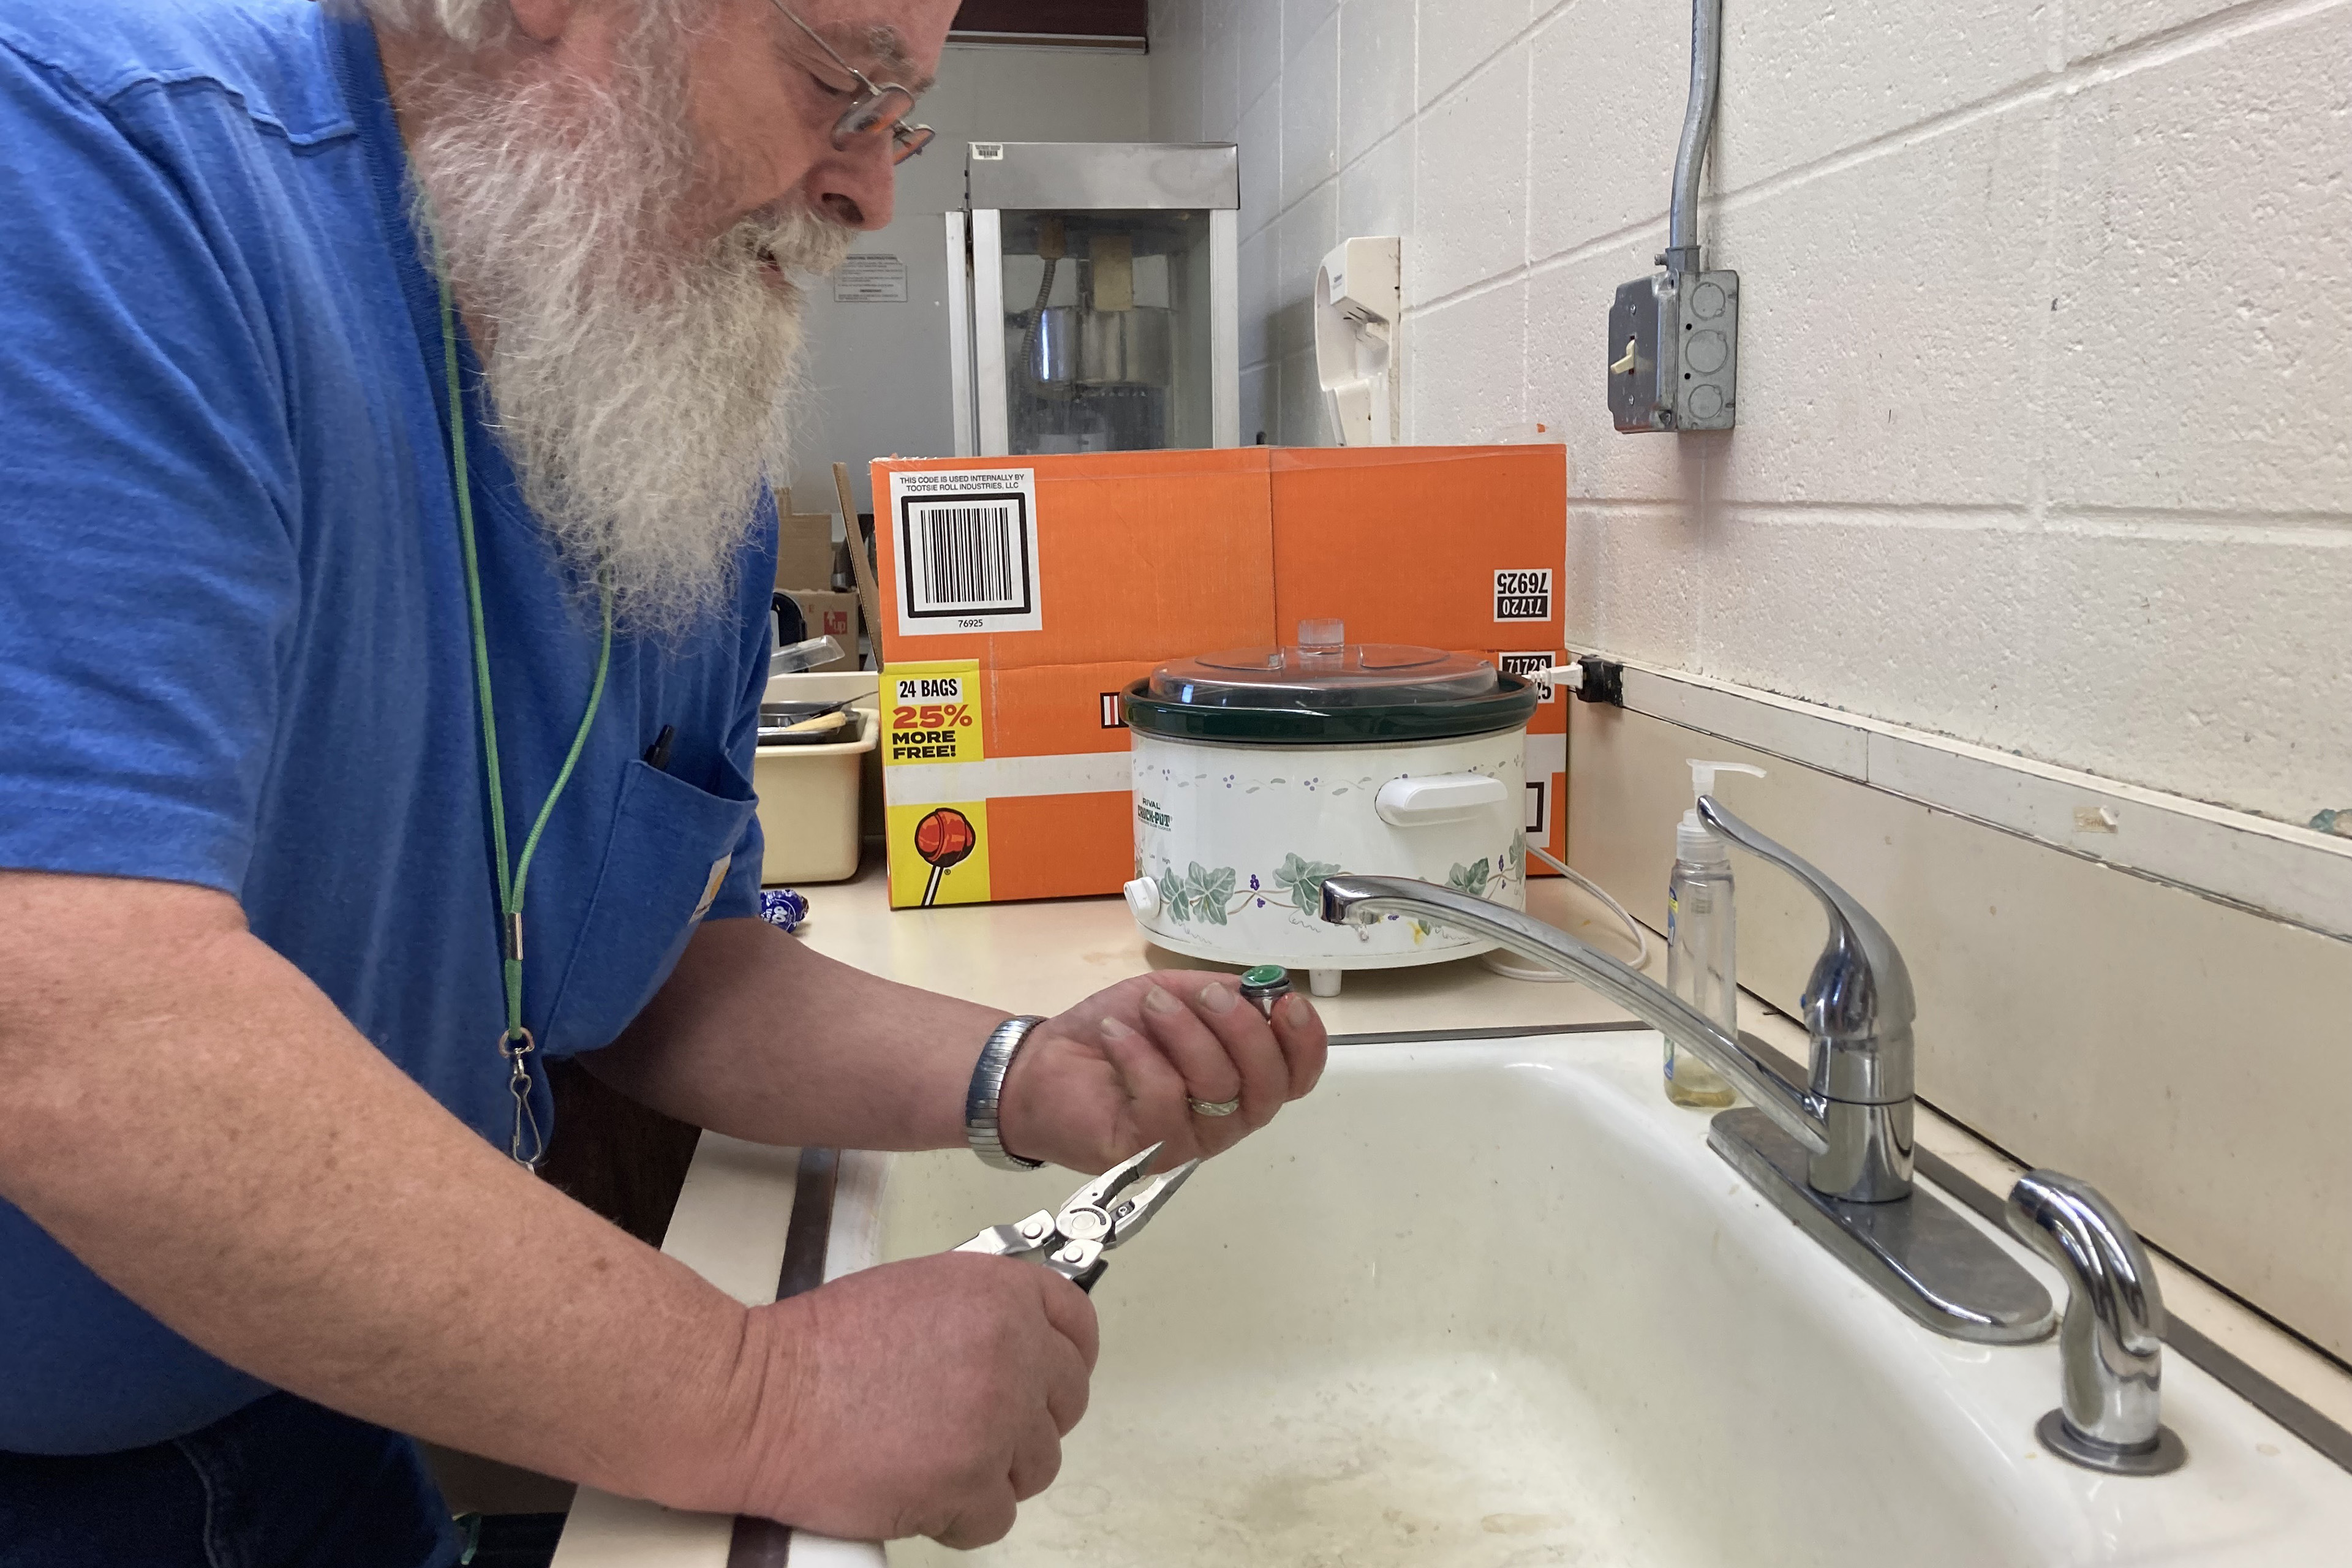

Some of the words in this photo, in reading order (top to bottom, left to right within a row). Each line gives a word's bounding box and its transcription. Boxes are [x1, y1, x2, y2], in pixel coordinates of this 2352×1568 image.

[1497, 572, 1548, 594] 76925
[1502, 598, 1542, 615] 71720
[958, 619, 983, 628] 76925
[899, 680, 916, 698] 24
[921, 679, 957, 697] BAGS
[892, 704, 973, 729] 25%
[892, 730, 956, 745] MORE
[893, 745, 956, 760] FREE!
[1142, 797, 1161, 810] RIVAL
